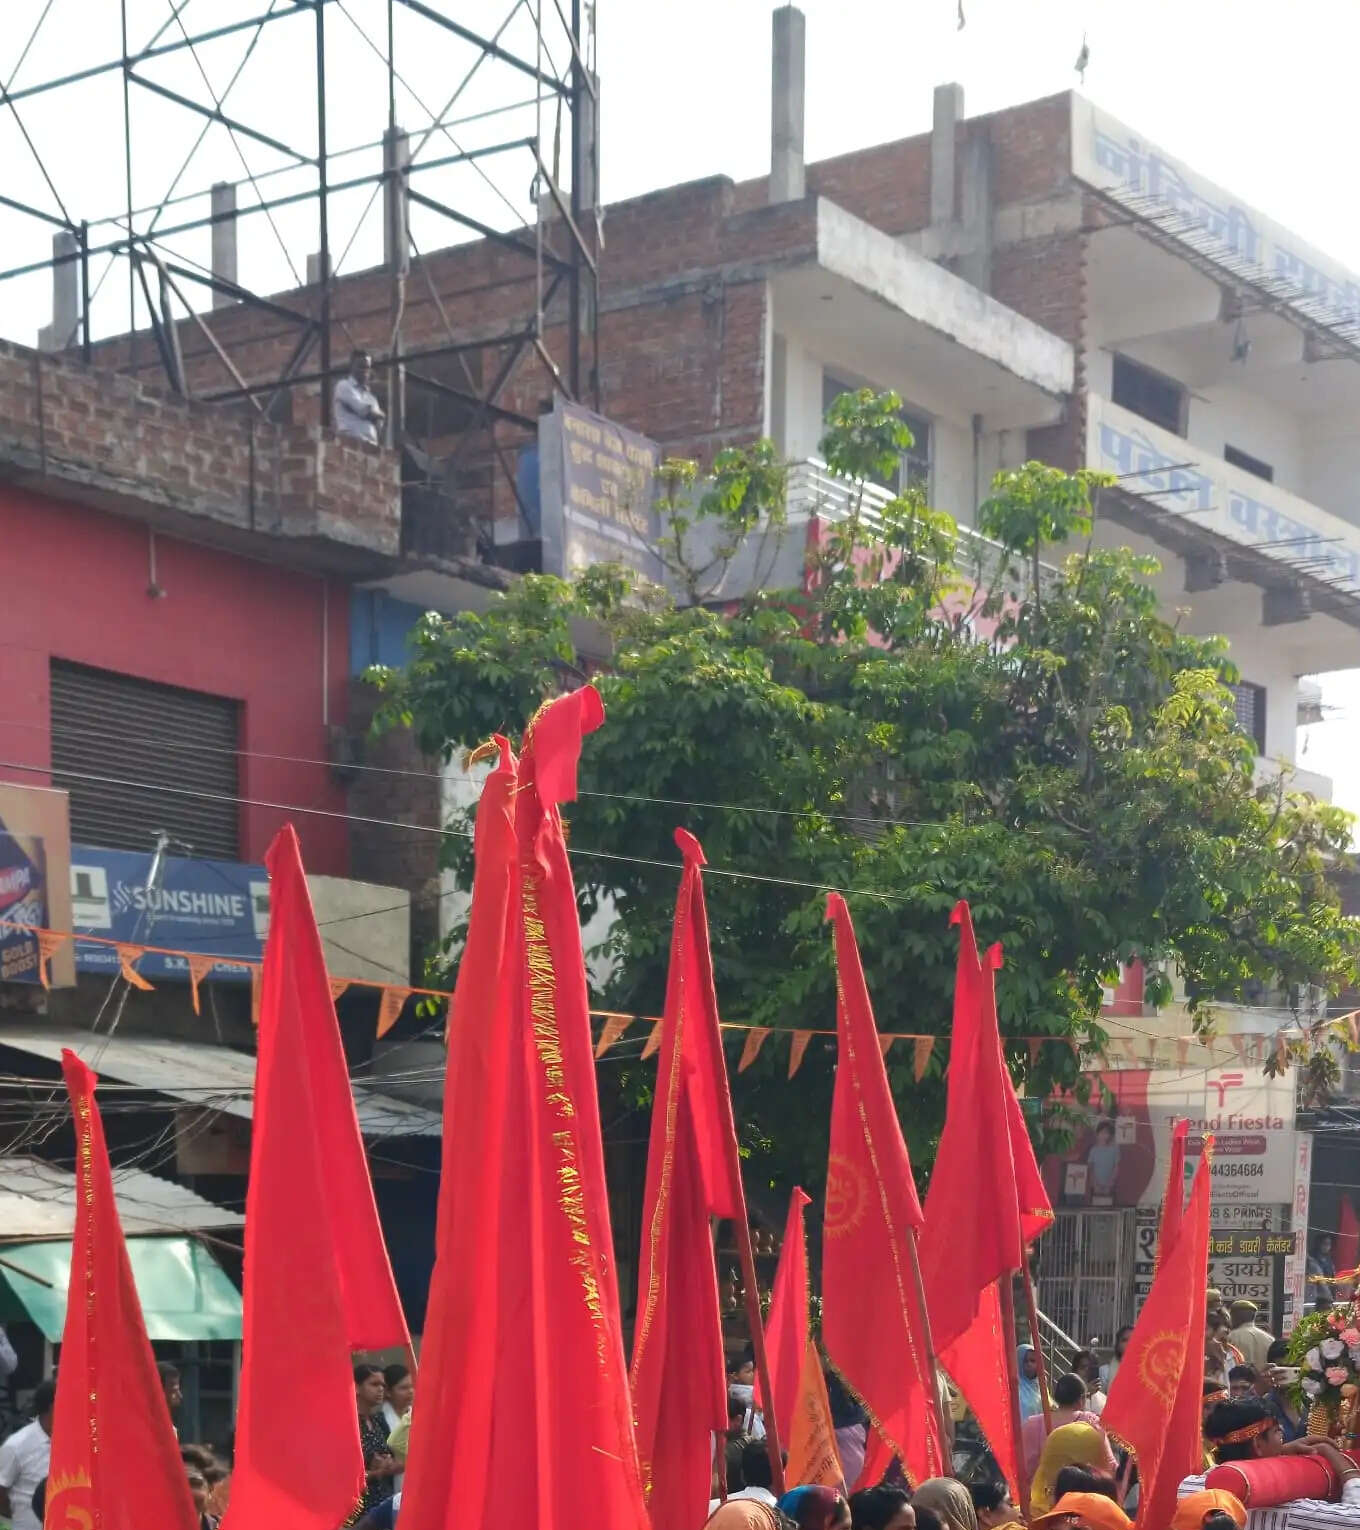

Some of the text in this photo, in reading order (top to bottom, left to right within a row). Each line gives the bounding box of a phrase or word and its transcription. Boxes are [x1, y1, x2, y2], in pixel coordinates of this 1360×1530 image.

[133, 886, 245, 917] SUNSHINE
[1228, 1114, 1284, 1130] Fiesta
[1233, 1207, 1273, 1219] PRINTS
[1239, 1236, 1261, 1254] डायरी
[1223, 1259, 1271, 1277] डायरी
